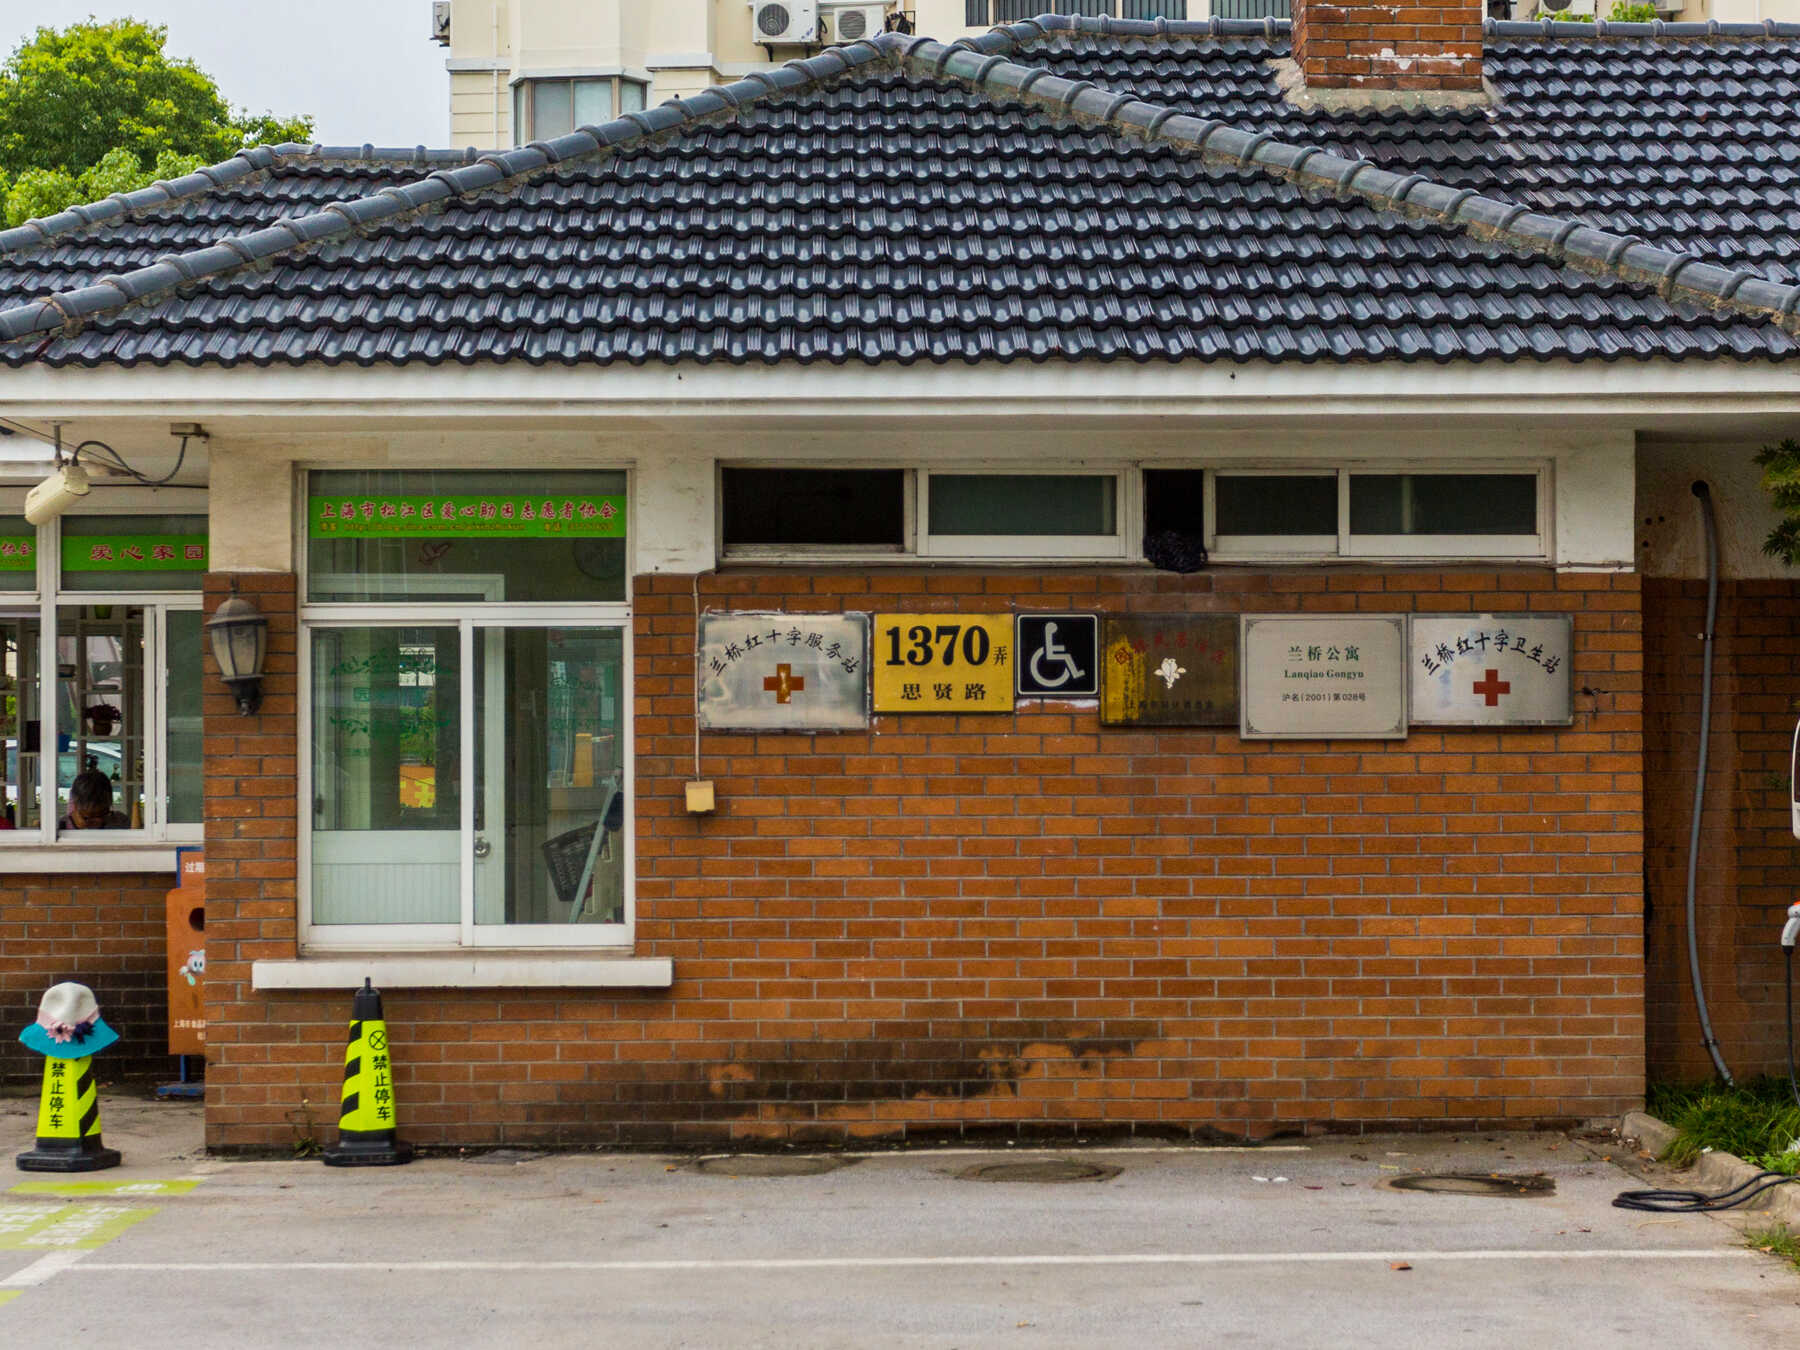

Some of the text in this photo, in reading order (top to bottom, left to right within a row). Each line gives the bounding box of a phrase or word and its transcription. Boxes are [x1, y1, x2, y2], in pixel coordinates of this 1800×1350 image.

[319, 500, 618, 521] 上海市松江区爱心助困志愿者协会
[90, 544, 205, 561] 爱心家园
[709, 626, 861, 675] 兰桥红十字服务站
[1287, 645, 1361, 662] 兰桥公寓
[1421, 628, 1562, 675] 兰桥红十字卫生站
[1284, 669, 1364, 681] Lanqiao Gongyu
[900, 682, 987, 701] 思贤路
[49, 1062, 65, 1128] 禁止停车
[372, 1055, 391, 1121] 禁止停车
